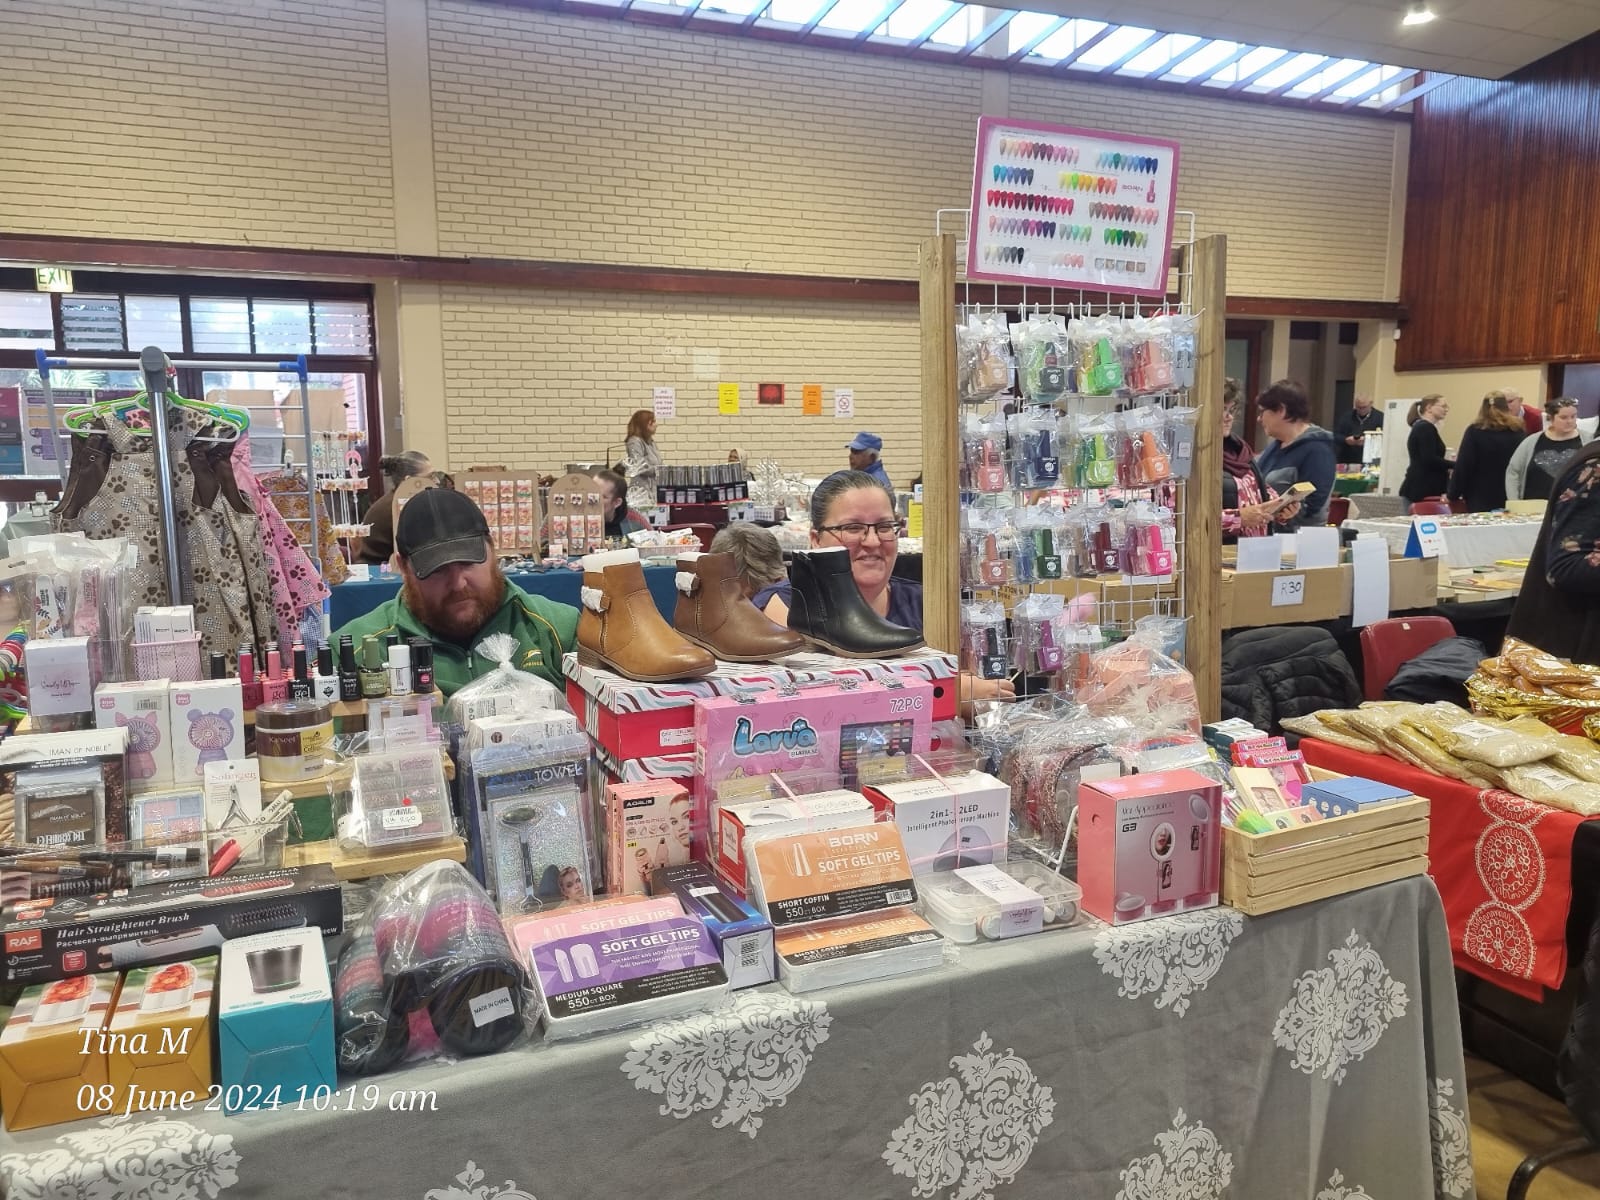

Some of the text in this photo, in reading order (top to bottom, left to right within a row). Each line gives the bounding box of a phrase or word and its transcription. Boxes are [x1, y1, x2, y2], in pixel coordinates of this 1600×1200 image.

[38, 266, 70, 285] EXIT
[1281, 582, 1301, 595] R30
[294, 686, 310, 702] gel
[889, 696, 922, 713] 72PC
[733, 717, 818, 756] Larva
[535, 762, 583, 782] TOWEL
[907, 822, 937, 832] Intelligent
[1122, 823, 1137, 832] G3
[829, 831, 879, 848] BORN
[818, 850, 900, 873] SOFT GEL TIPS
[778, 898, 803, 909] SHORT
[804, 894, 830, 905] COFFIN
[812, 906, 826, 914] BOX
[57, 913, 191, 939] Hair Straightener Brush
[581, 909, 675, 931] SOFT GEL TIPS
[9, 936, 38, 947] RAF
[602, 928, 700, 955] SOFT GEL TIPS
[555, 982, 624, 1003] MEDIUM SQUARE
[599, 993, 617, 1003] BOX
